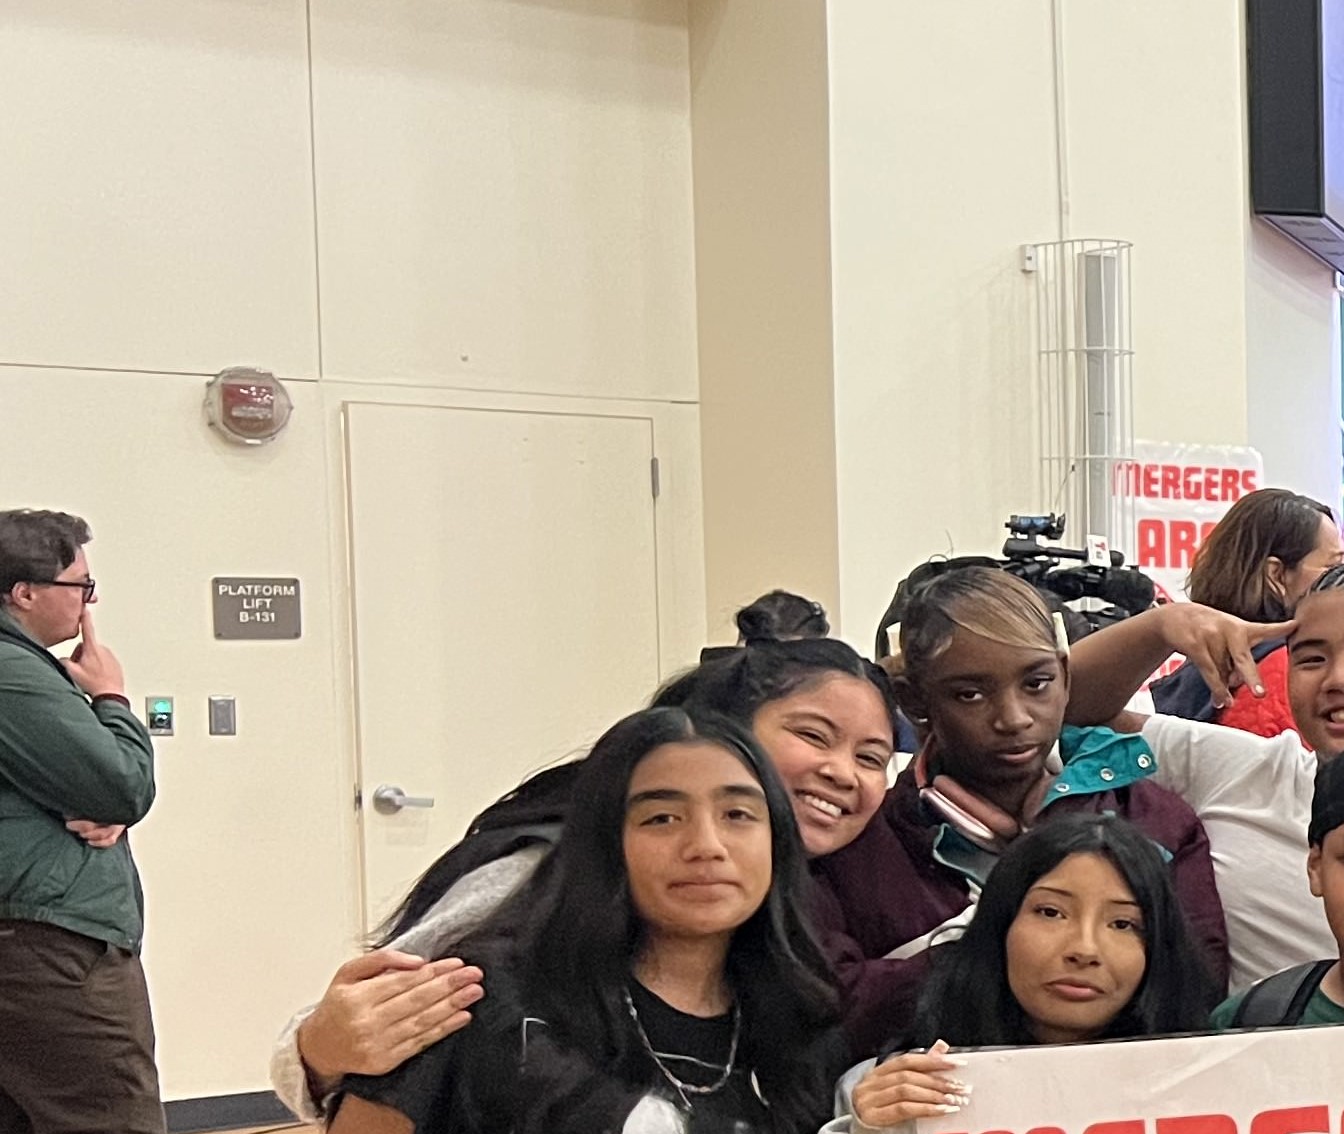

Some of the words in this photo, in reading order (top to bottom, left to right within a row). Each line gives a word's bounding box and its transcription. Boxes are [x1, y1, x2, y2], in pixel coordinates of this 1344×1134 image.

[1112, 462, 1258, 502] MERGERS
[218, 584, 296, 597] PLATFORM
[243, 598, 273, 610] LIFT
[239, 610, 276, 623] B-131
